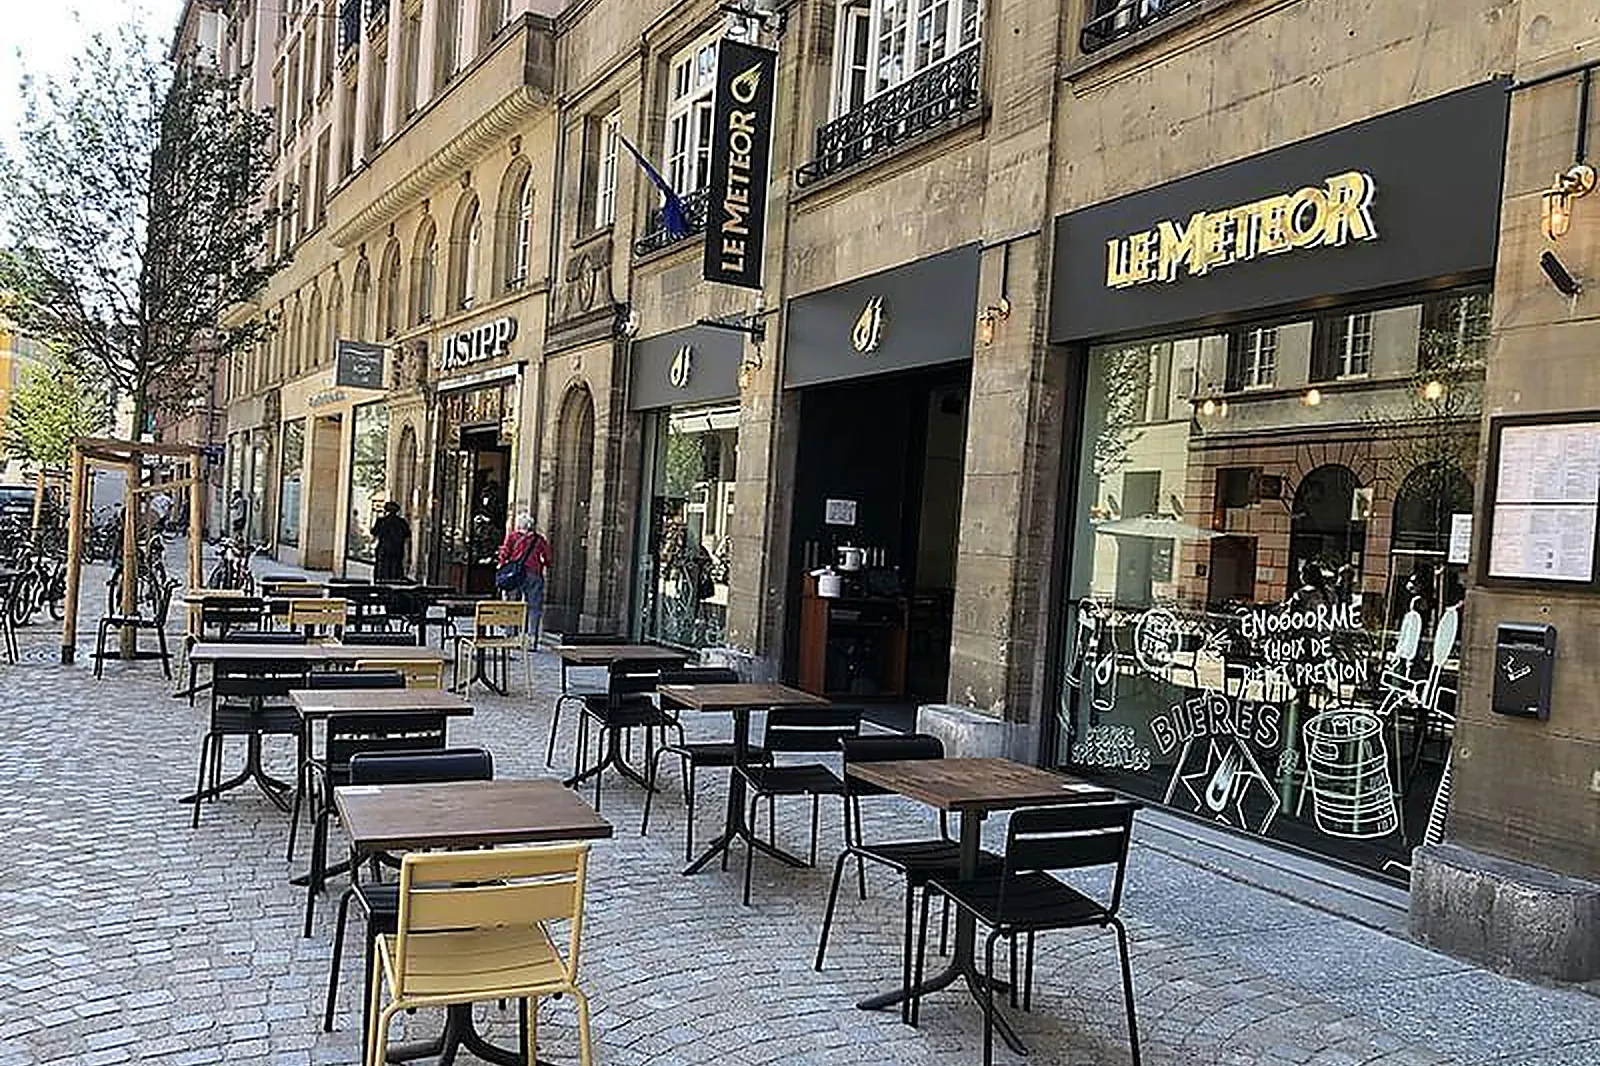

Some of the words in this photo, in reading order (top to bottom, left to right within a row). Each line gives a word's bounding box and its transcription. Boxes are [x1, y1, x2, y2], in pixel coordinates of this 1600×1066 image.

[721, 109, 757, 235] METEOR
[720, 238, 746, 273] LE
[1105, 231, 1157, 289] LE
[1156, 170, 1377, 283] METEOR
[1311, 636, 1333, 658] DE
